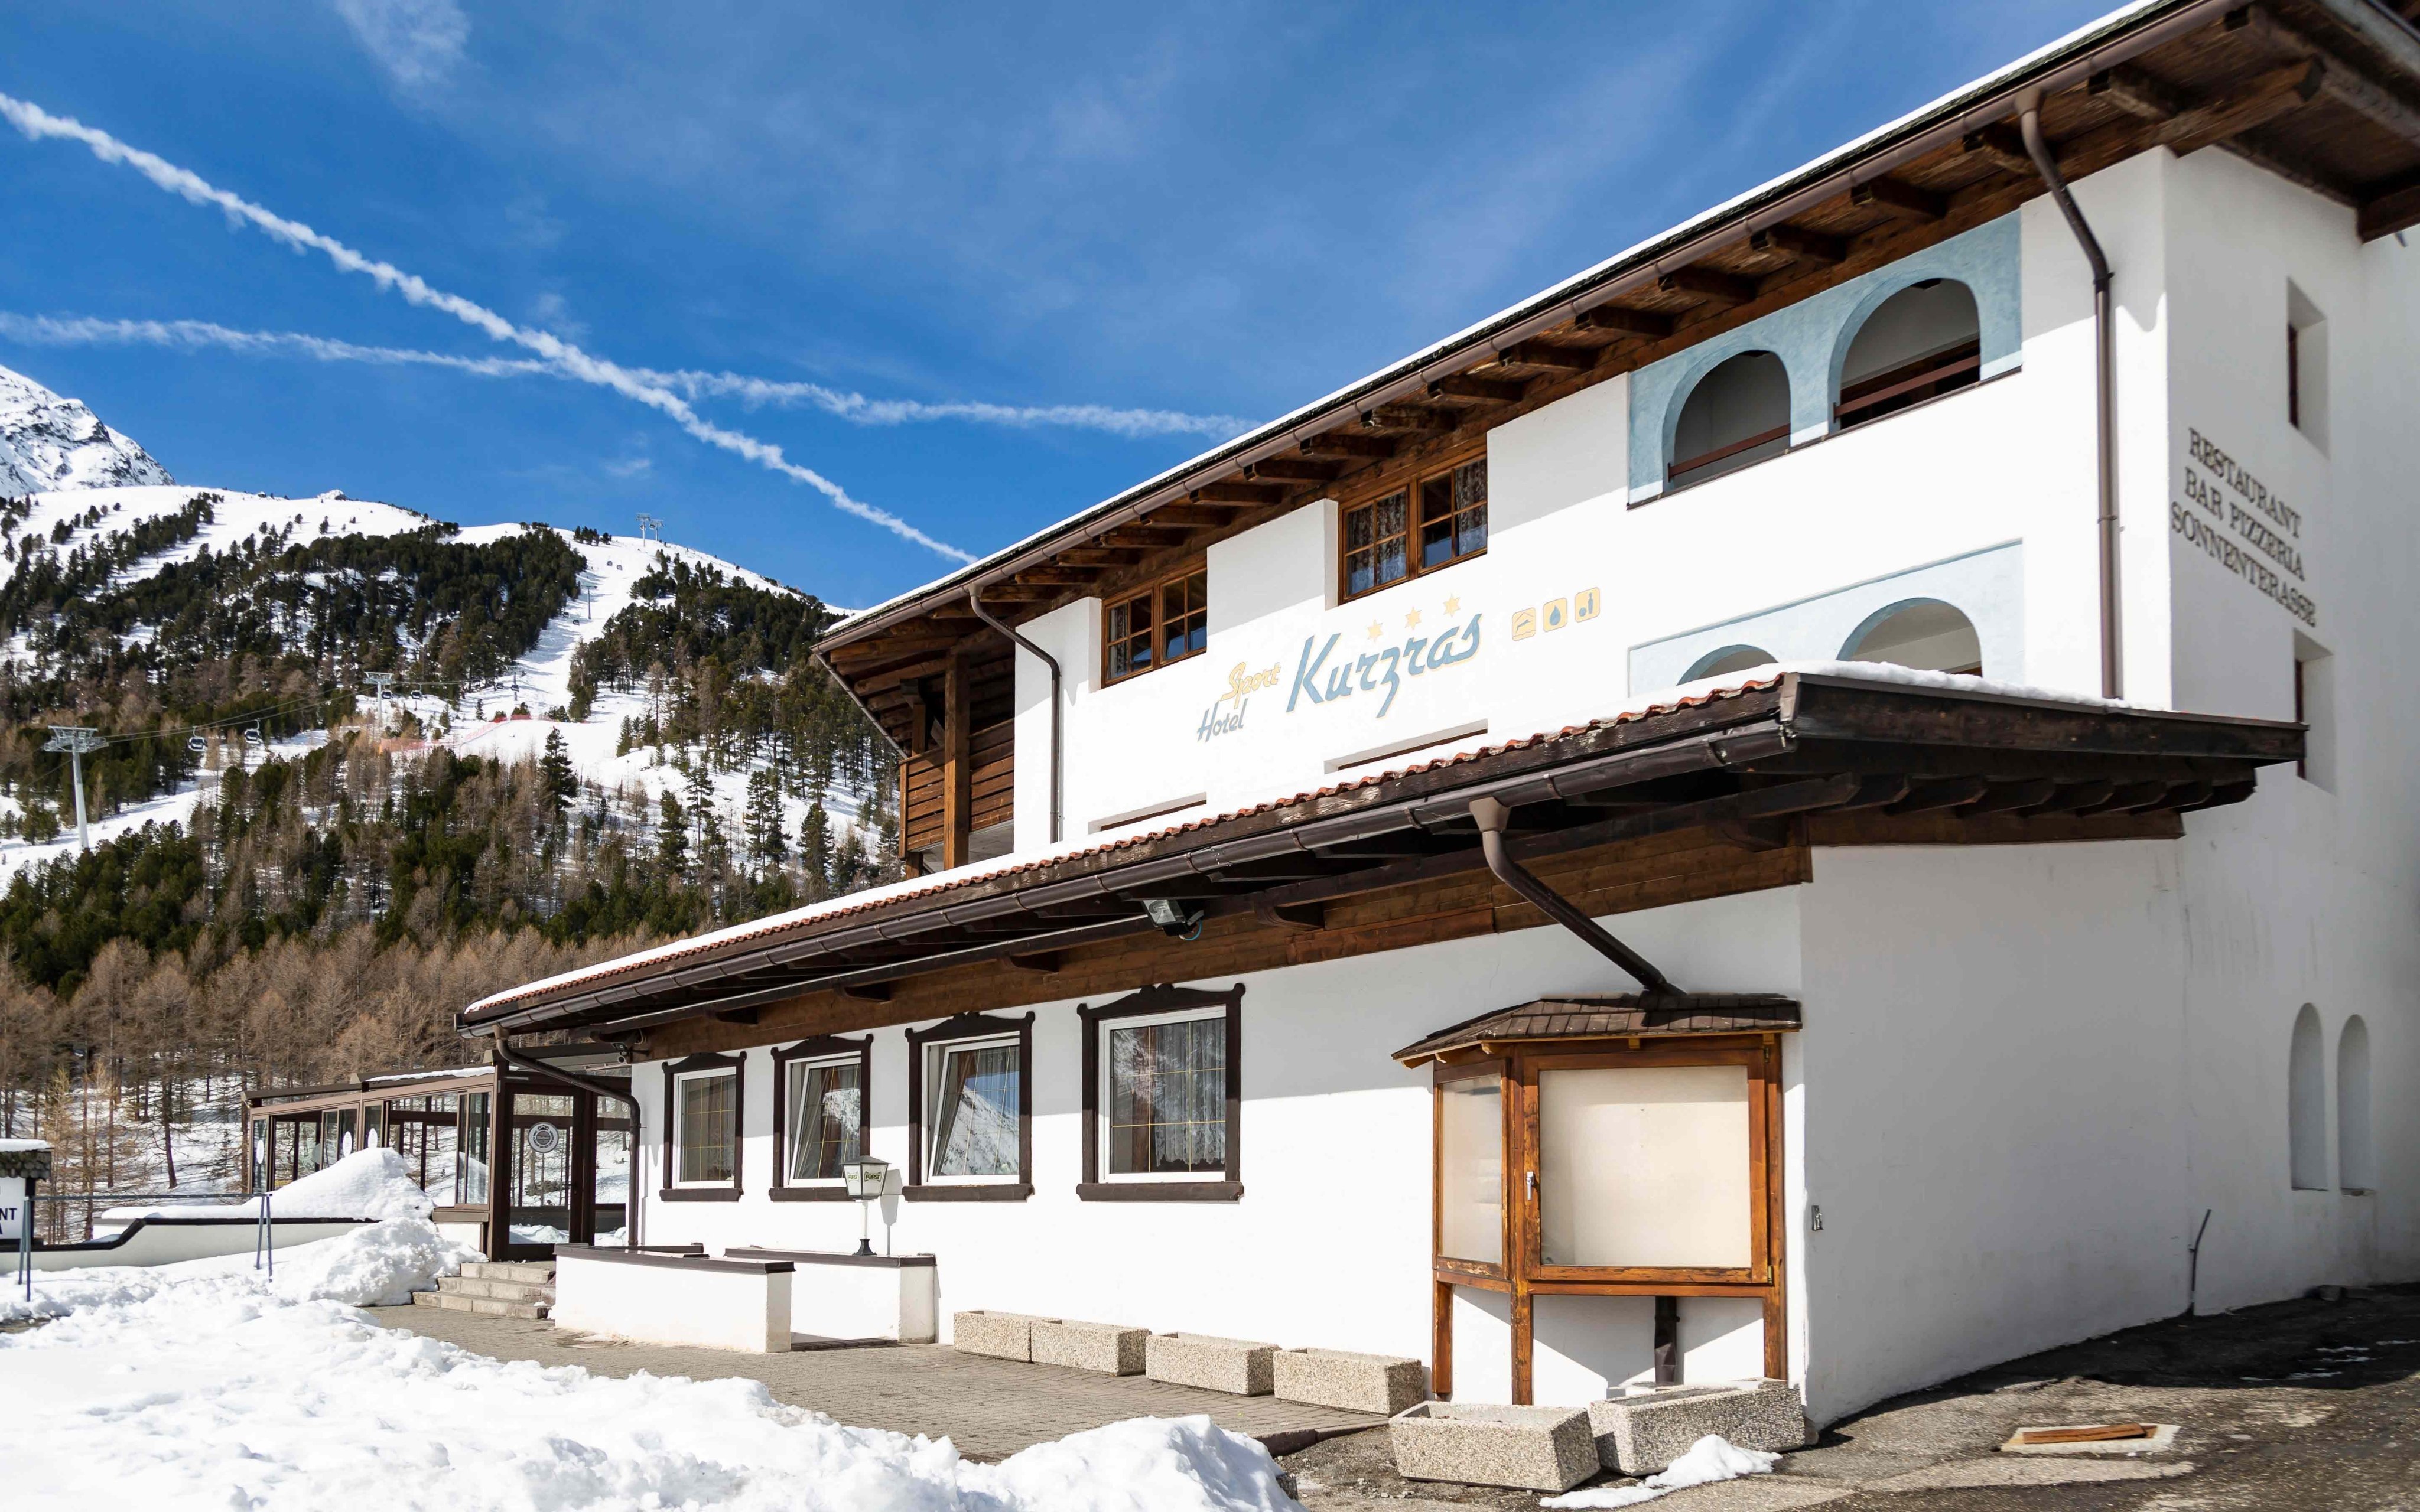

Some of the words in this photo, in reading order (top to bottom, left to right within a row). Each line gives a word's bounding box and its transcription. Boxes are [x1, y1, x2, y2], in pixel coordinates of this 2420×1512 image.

[2188, 426, 2302, 539] RESTAURANT
[2185, 466, 2224, 521] BAR
[2229, 501, 2305, 582] PIZZERIA
[1196, 698, 1248, 742] Hotel
[1219, 662, 1281, 710] Sport
